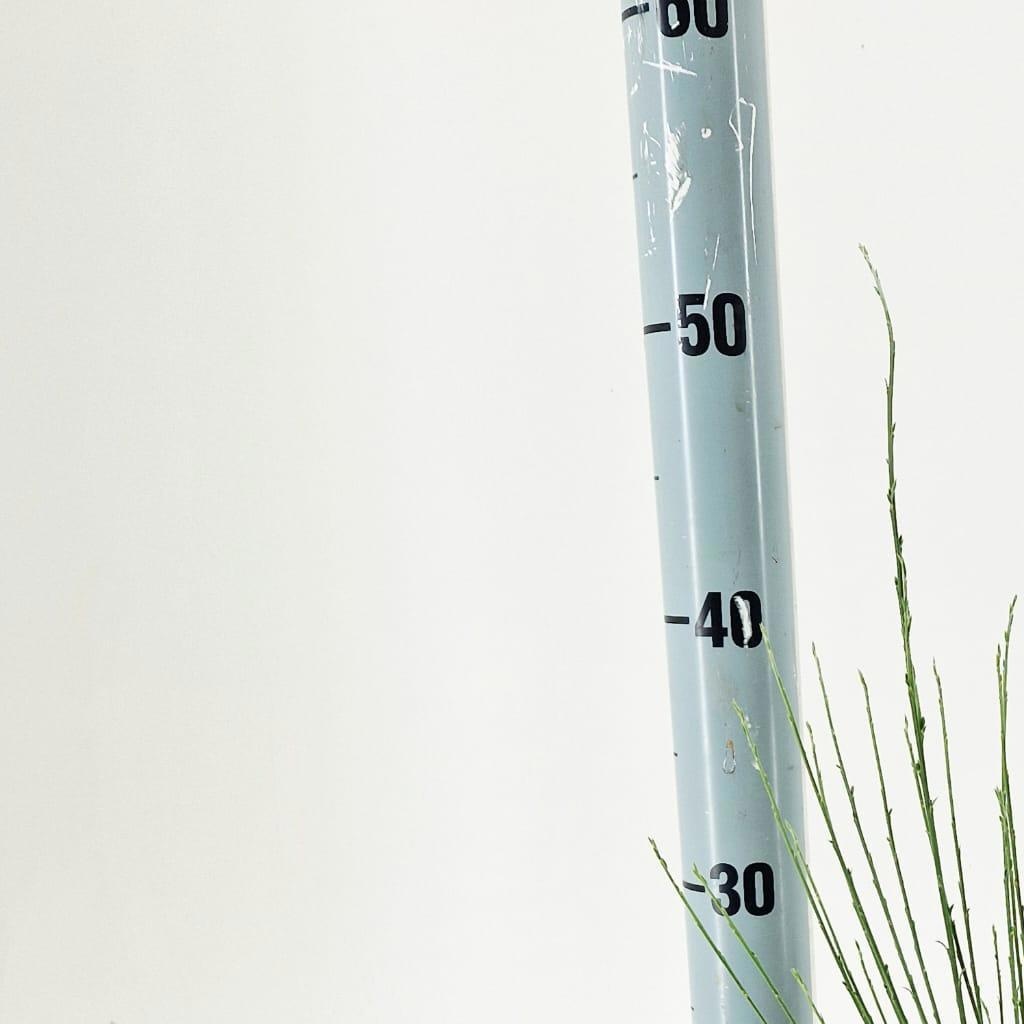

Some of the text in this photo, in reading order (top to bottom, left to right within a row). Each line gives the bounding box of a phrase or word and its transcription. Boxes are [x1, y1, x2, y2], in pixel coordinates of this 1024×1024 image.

[678, 293, 747, 357] 50
[694, 591, 763, 649] 40
[709, 862, 774, 917] 30
